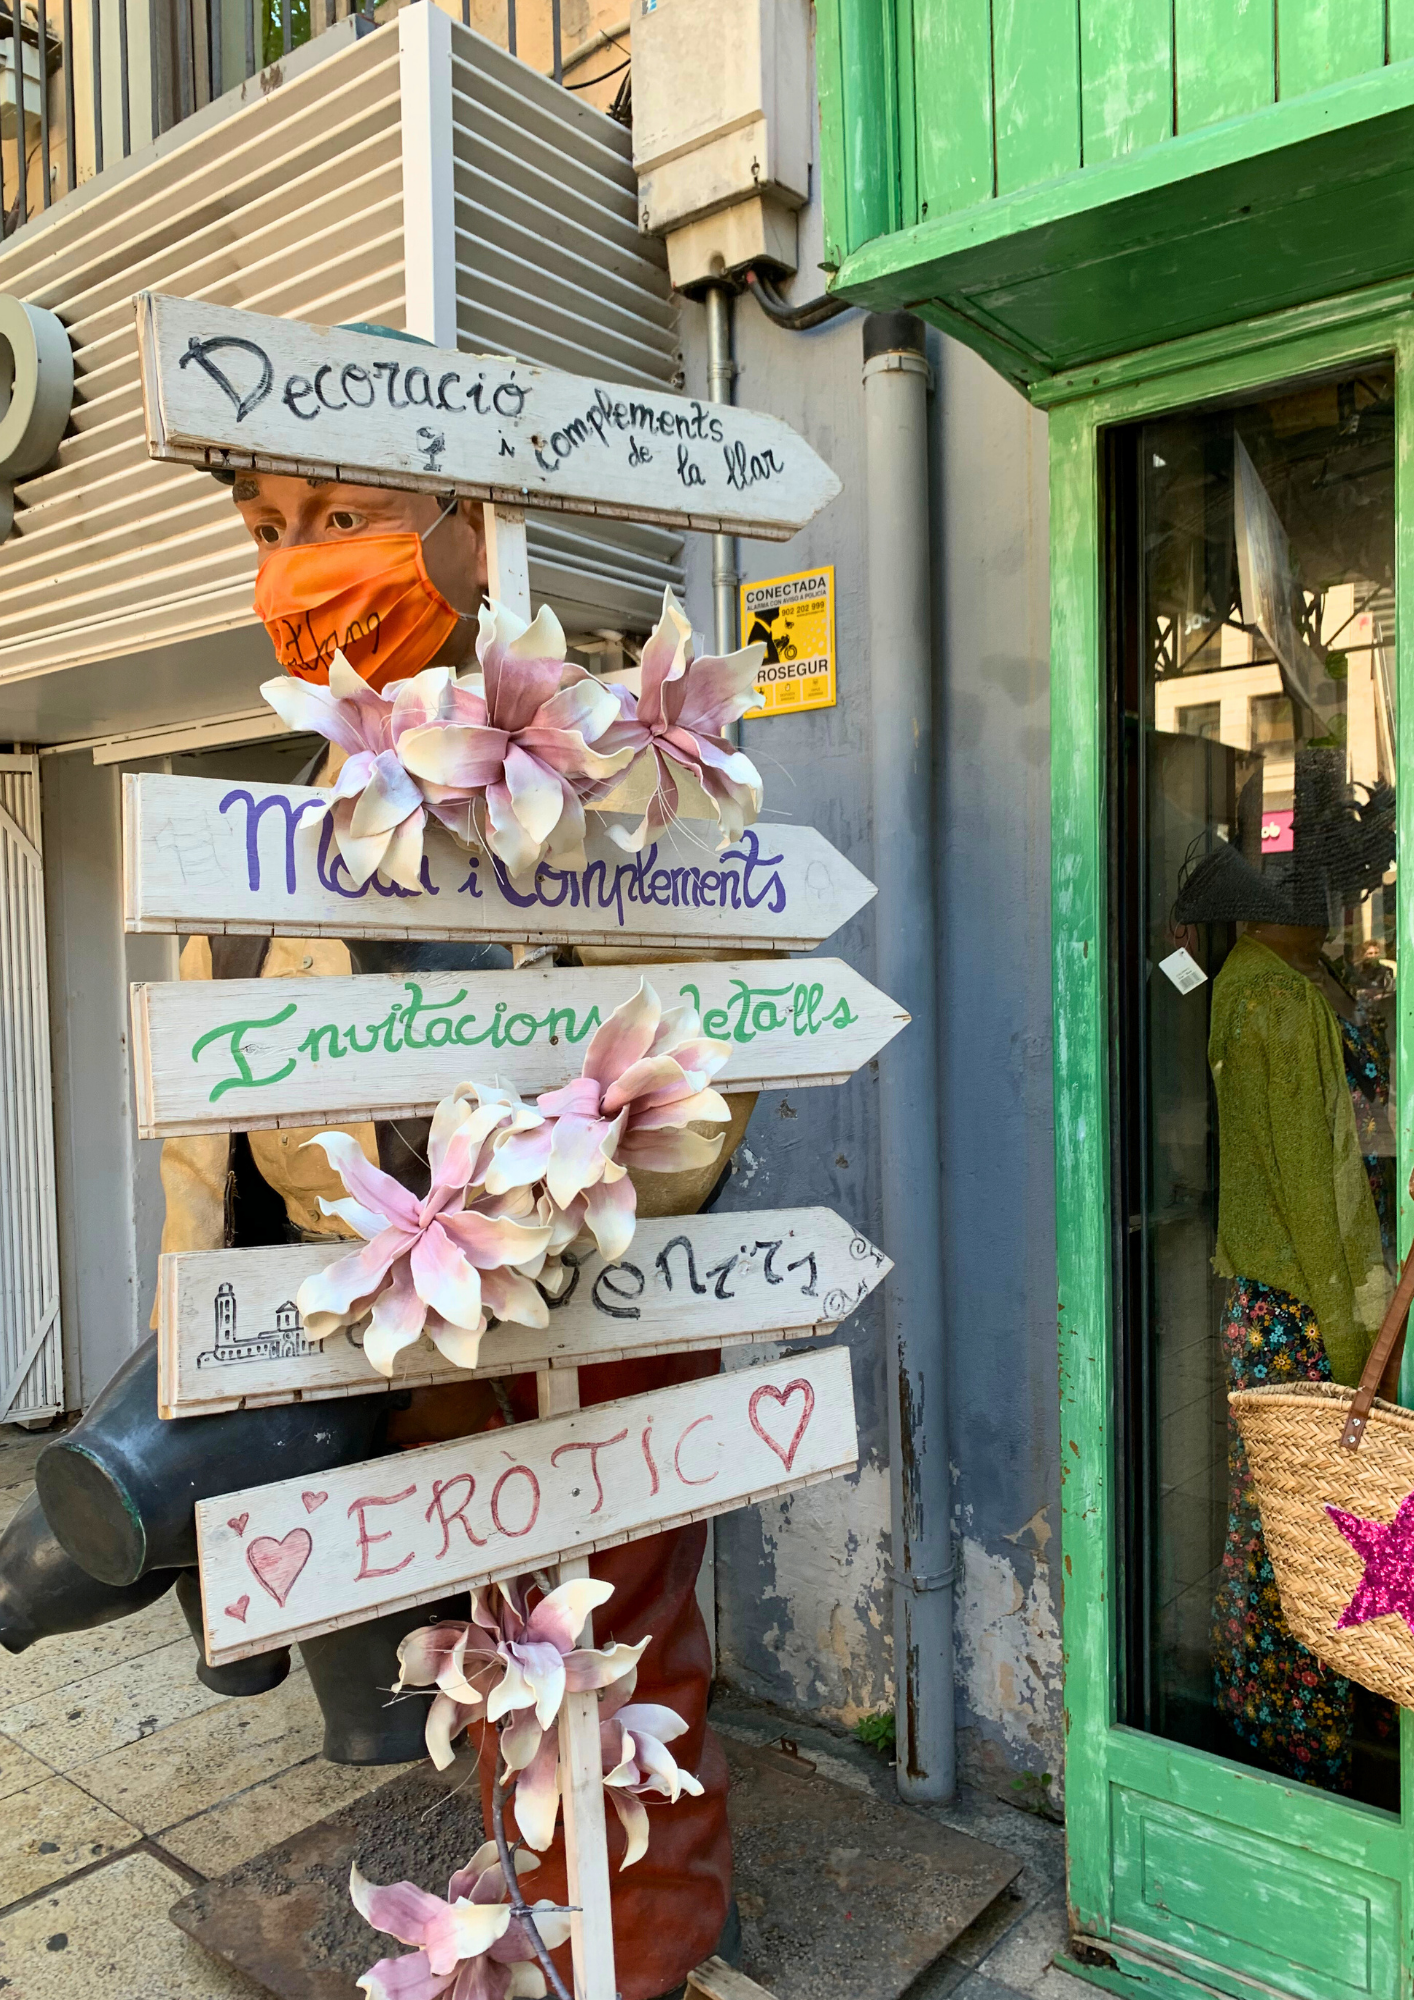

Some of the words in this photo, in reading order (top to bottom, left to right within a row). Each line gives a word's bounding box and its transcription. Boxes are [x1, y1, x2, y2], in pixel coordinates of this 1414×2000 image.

[179, 336, 532, 423] Decoració
[498, 430, 515, 458] i
[534, 388, 724, 471] complements
[627, 436, 654, 467] de
[676, 443, 706, 486] la
[723, 440, 785, 490] llar
[746, 576, 827, 603] CONECTADA
[746, 601, 770, 611] ALARMA
[769, 599, 782, 607] CON
[782, 595, 799, 604] AVISO
[804, 589, 827, 599] POLICÍA
[781, 607, 795, 616] 902
[796, 604, 810, 614] 202
[811, 600, 825, 610] 999
[757, 659, 828, 683] ROSEGUR
[458, 857, 483, 898] i
